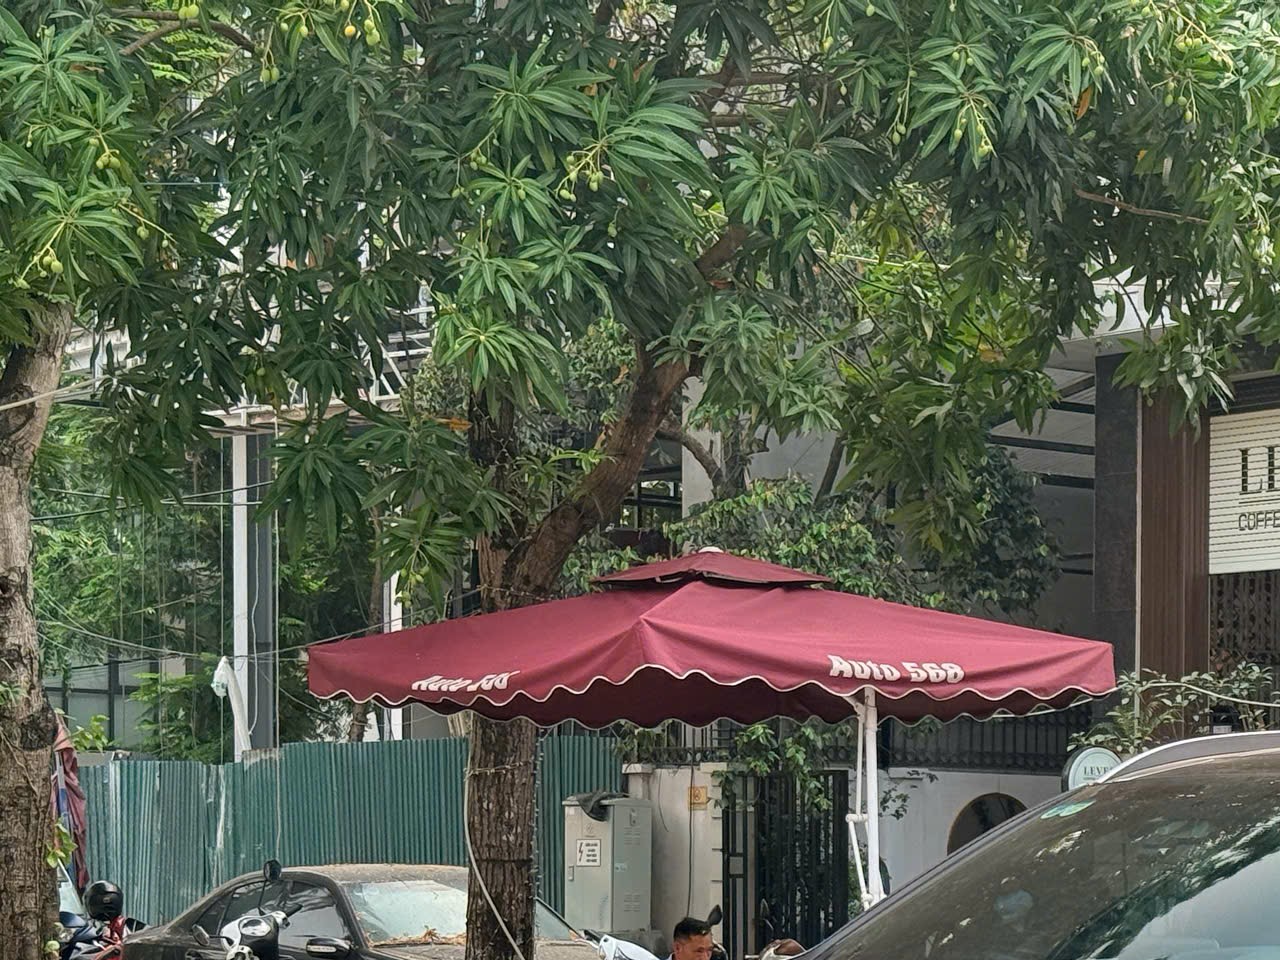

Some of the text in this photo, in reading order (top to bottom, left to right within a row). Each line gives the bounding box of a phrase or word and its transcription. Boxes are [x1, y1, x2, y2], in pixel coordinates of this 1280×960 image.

[827, 654, 965, 684] Auto 568
[1084, 766, 1112, 776] LEVE
